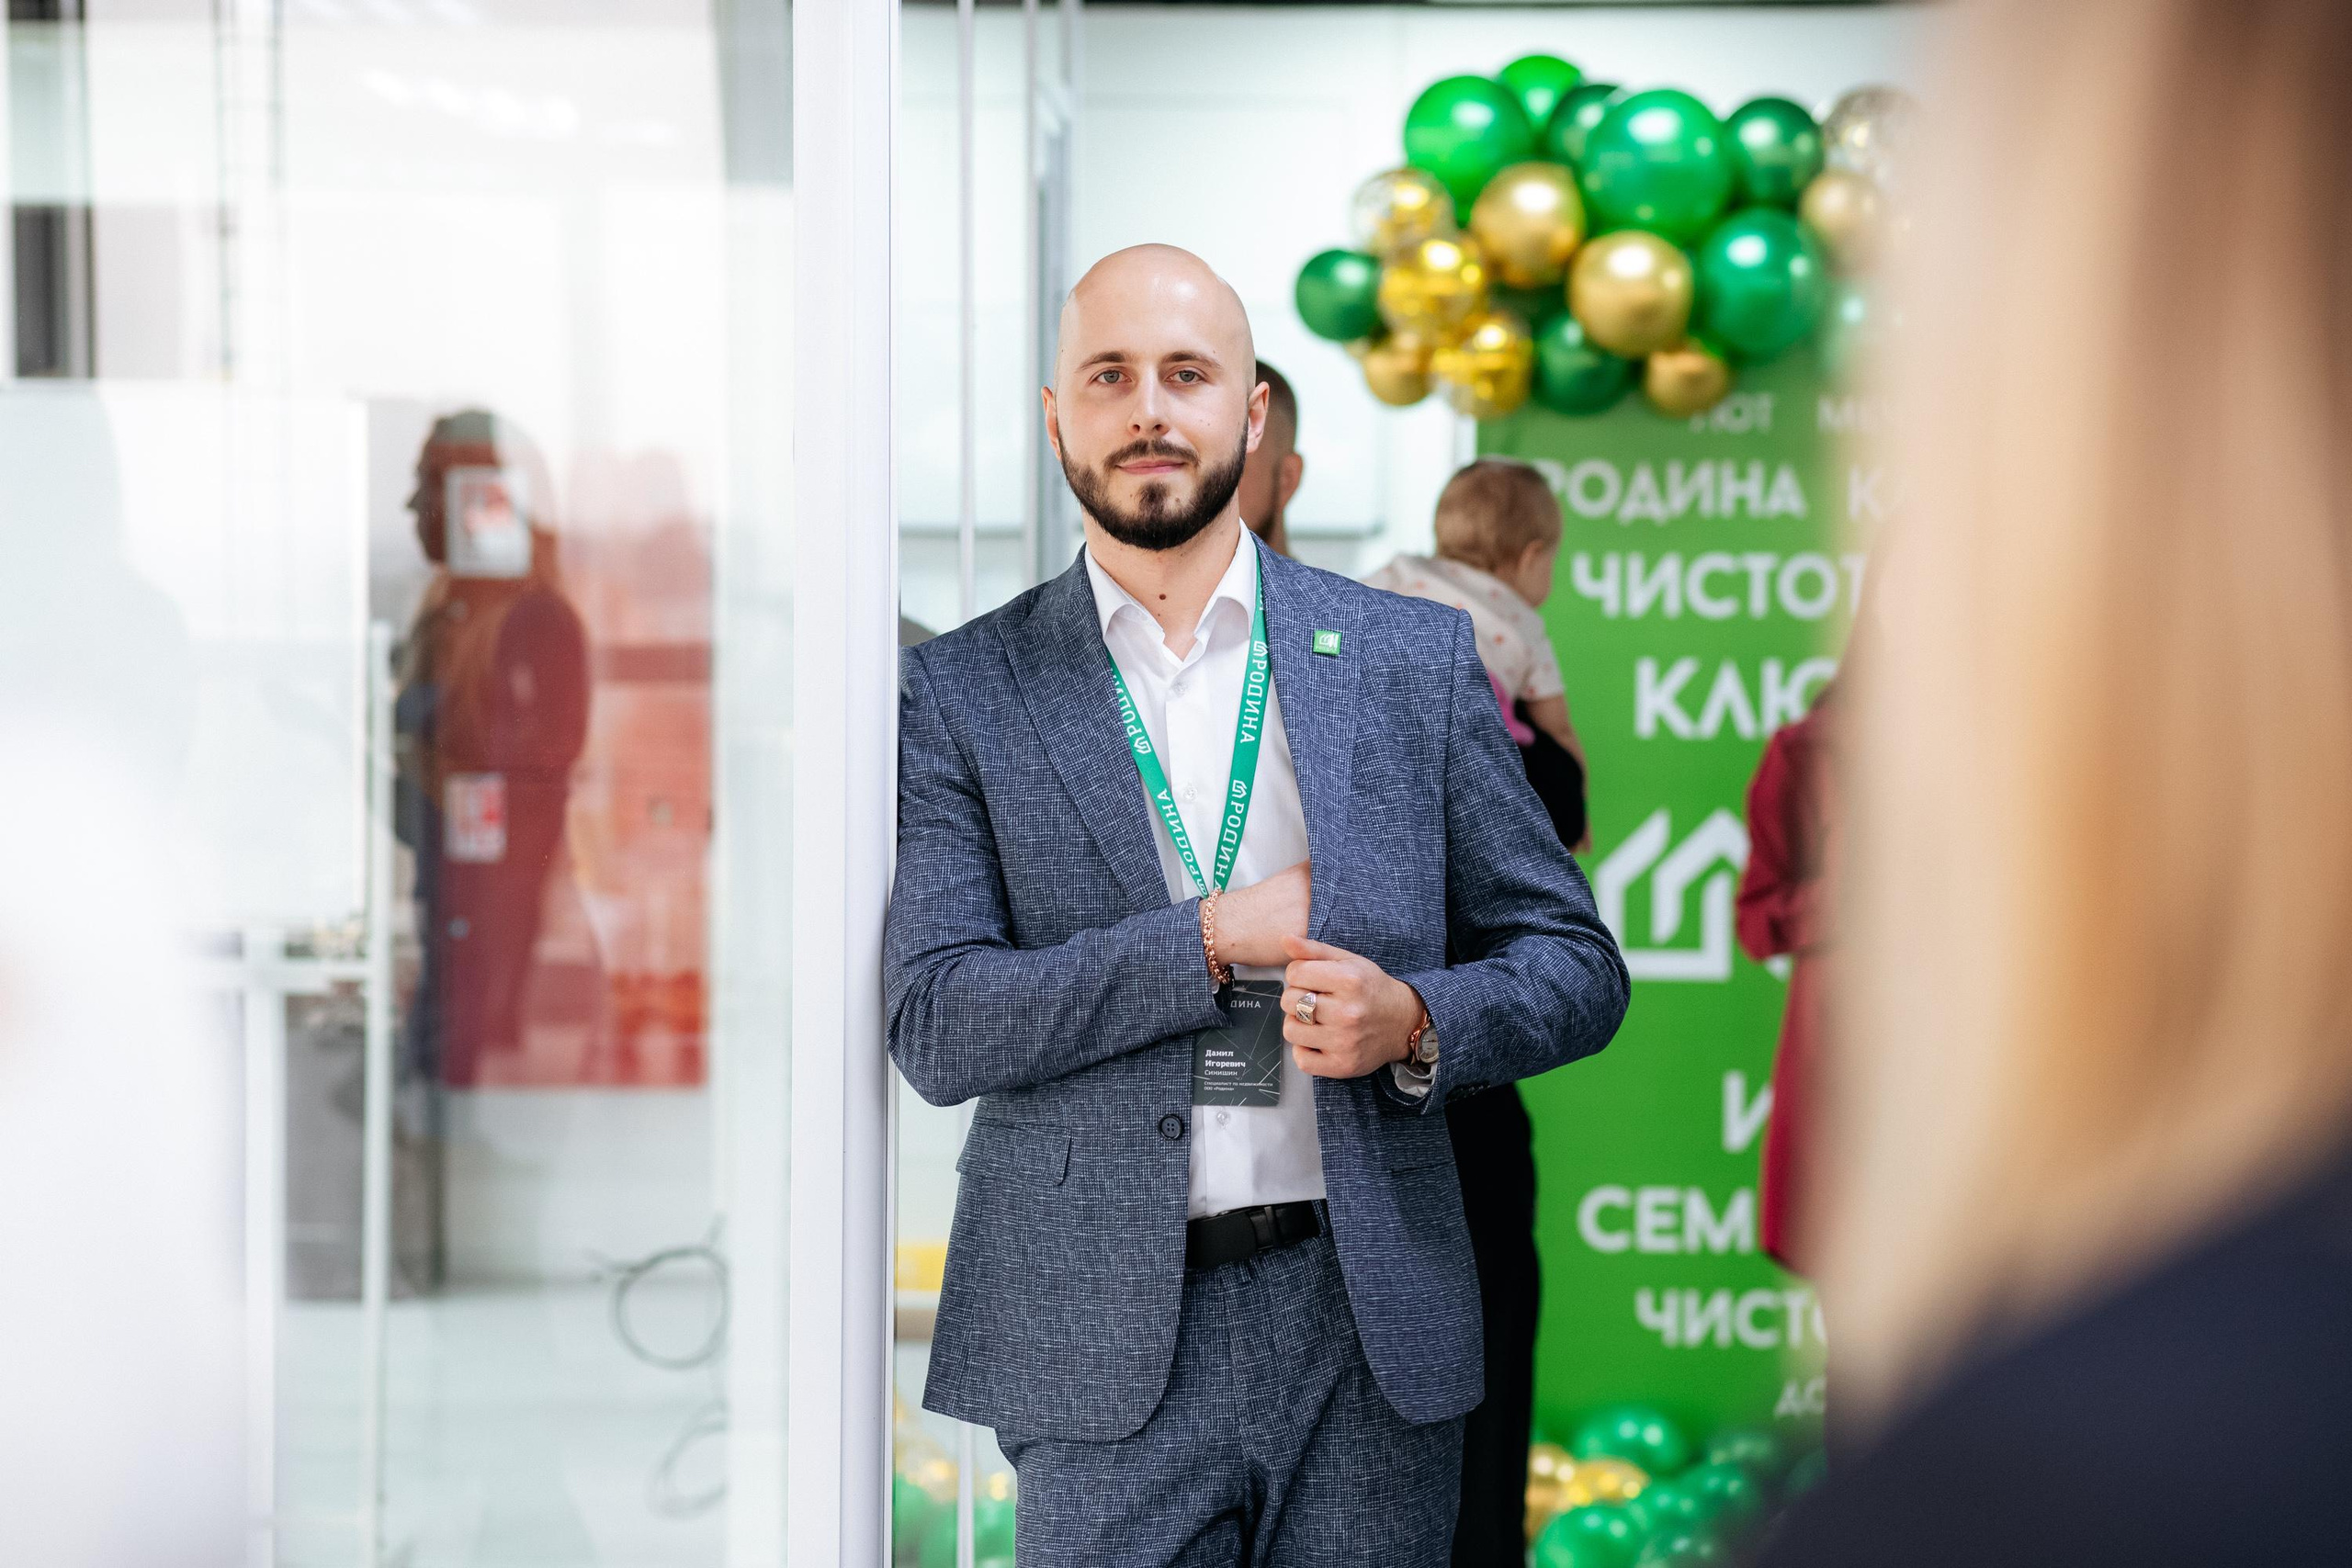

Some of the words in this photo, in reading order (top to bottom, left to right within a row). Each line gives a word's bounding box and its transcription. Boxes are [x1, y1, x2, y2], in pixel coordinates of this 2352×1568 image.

[1240, 658, 1268, 743] РОДИНА
[1158, 788, 1200, 876] РОДИНА
[1204, 1060, 1246, 1068] Игоревич
[1205, 1049, 1234, 1057] Данил
[1577, 1184, 1758, 1253] СЕМ
